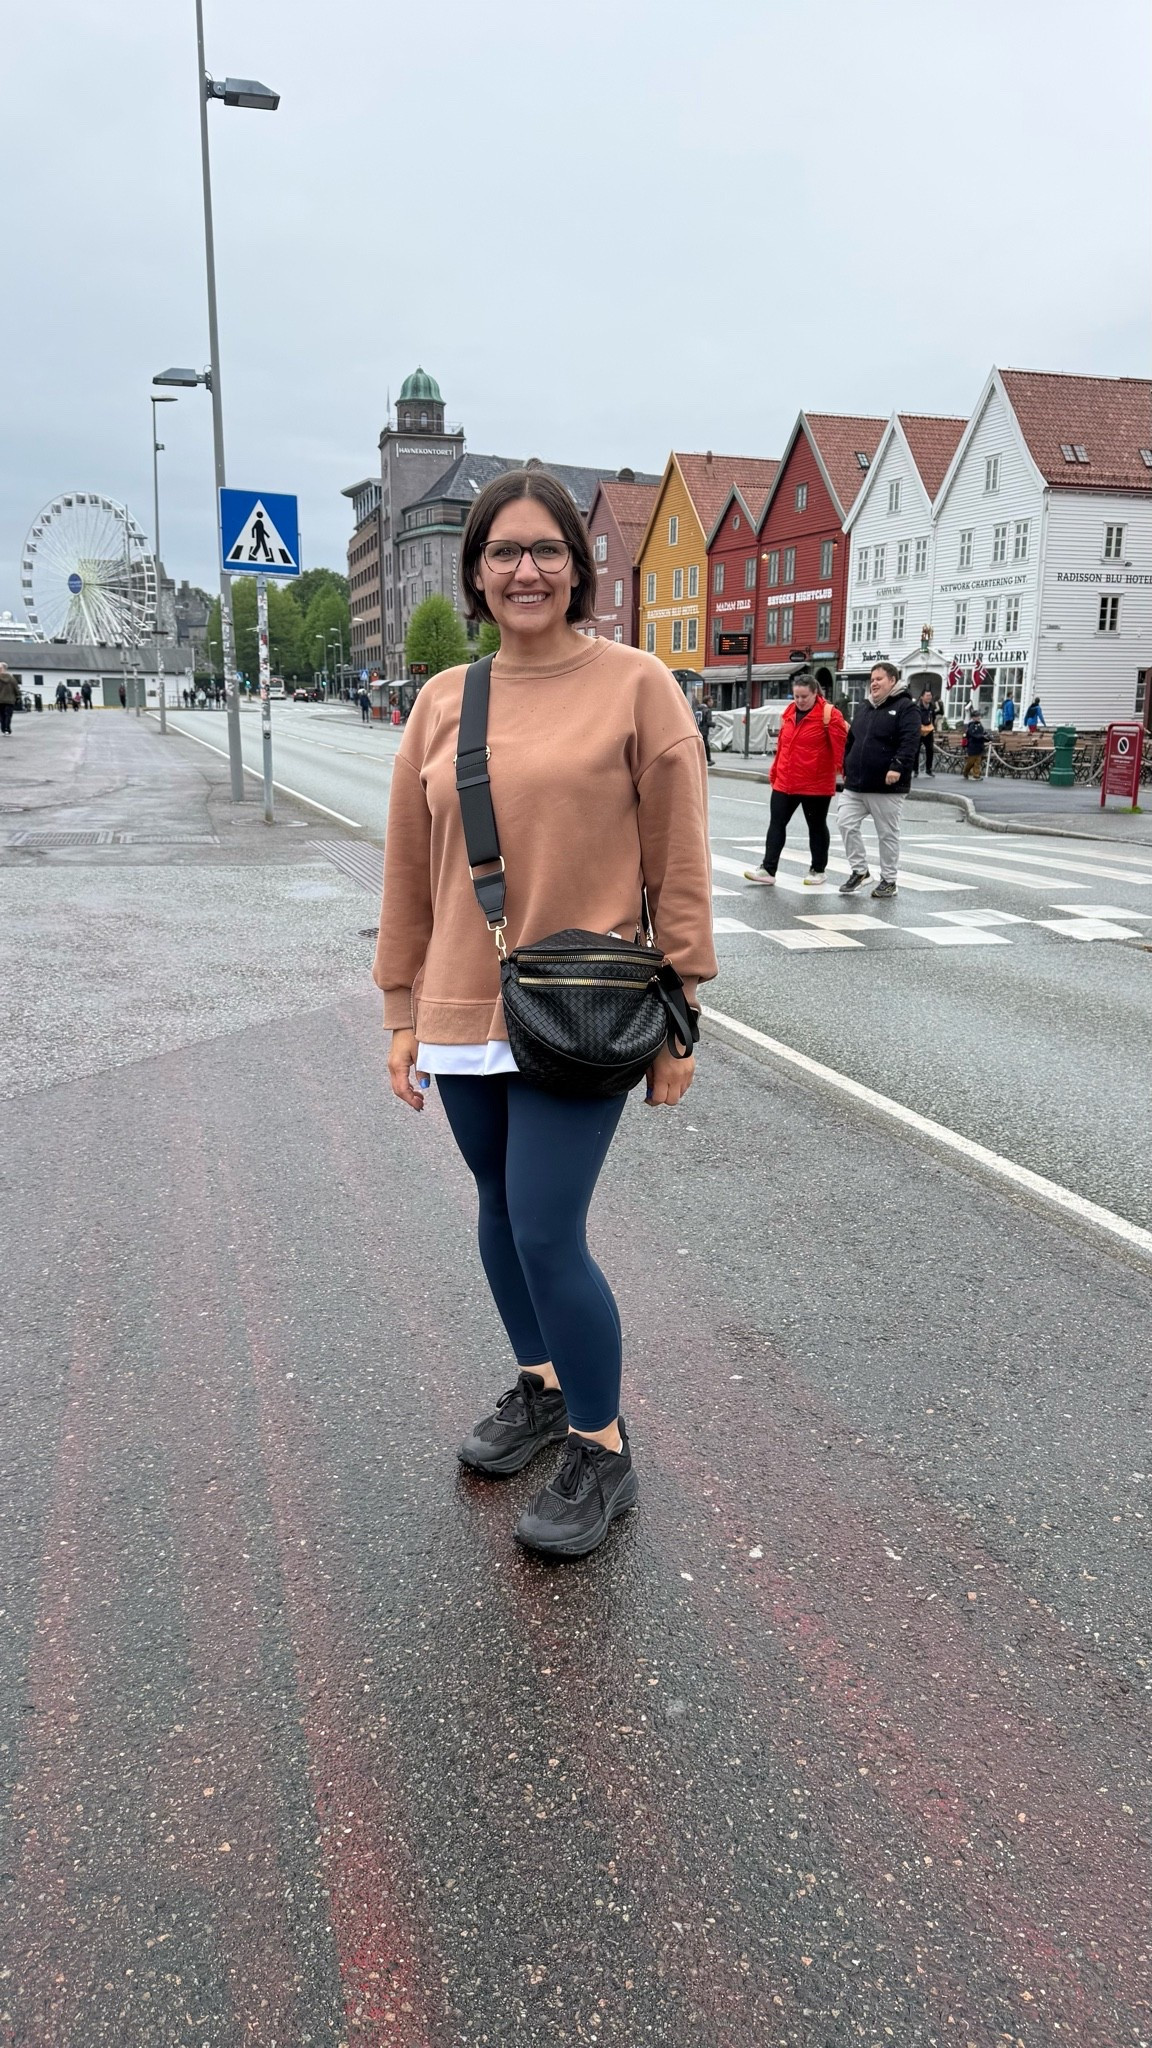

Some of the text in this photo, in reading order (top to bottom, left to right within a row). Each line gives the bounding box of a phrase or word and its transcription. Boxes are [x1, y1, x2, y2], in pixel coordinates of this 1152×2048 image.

[399, 447, 453, 456] HAVNEKONTORET
[939, 582, 971, 593] NETWORK
[971, 577, 1013, 589] CHARTERING
[1057, 572, 1103, 583] RADISSON
[1105, 573, 1123, 584] BLU
[795, 588, 833, 602] NIGHTCLUB
[953, 650, 1029, 664] SILVER GALLERY
